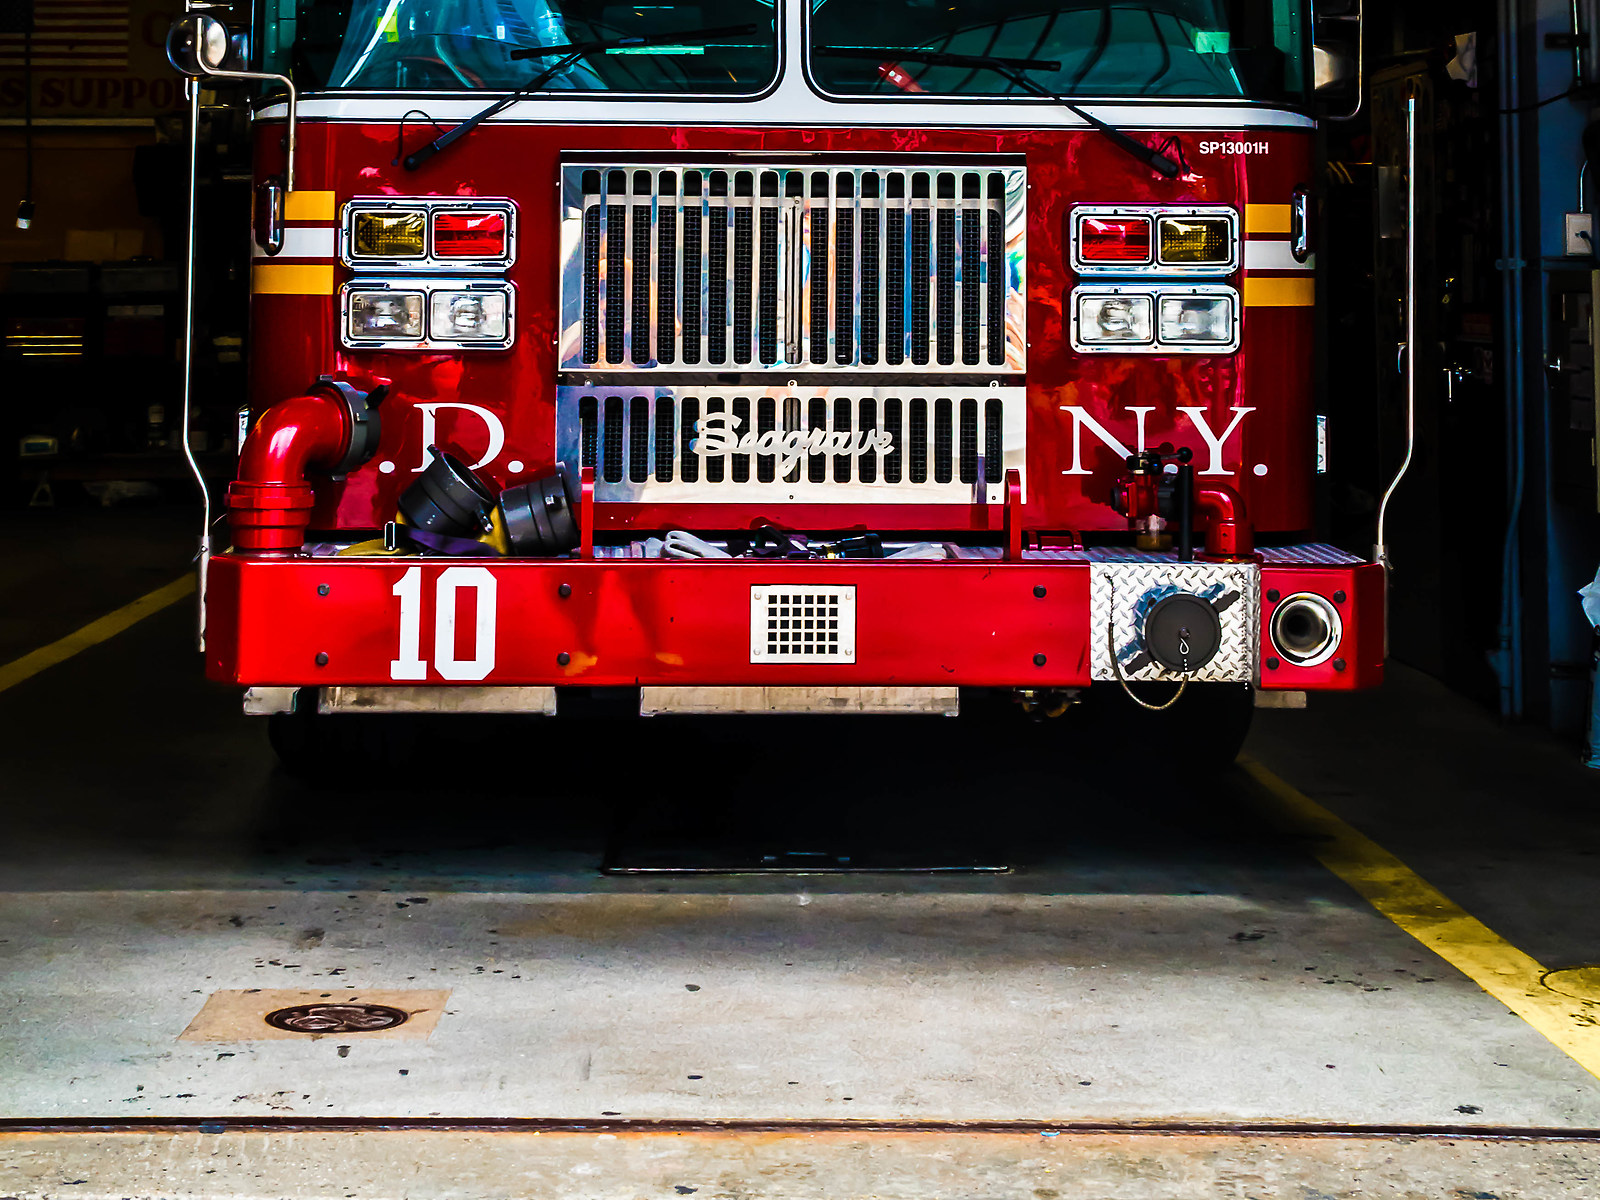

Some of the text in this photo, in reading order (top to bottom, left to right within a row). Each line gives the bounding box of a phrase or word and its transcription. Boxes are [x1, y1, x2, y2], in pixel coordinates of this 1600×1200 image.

[1199, 141, 1269, 155] SP13001H
[689, 411, 895, 477] Seagrave
[1059, 405, 1268, 476] N.Y.
[390, 566, 498, 681] 10
